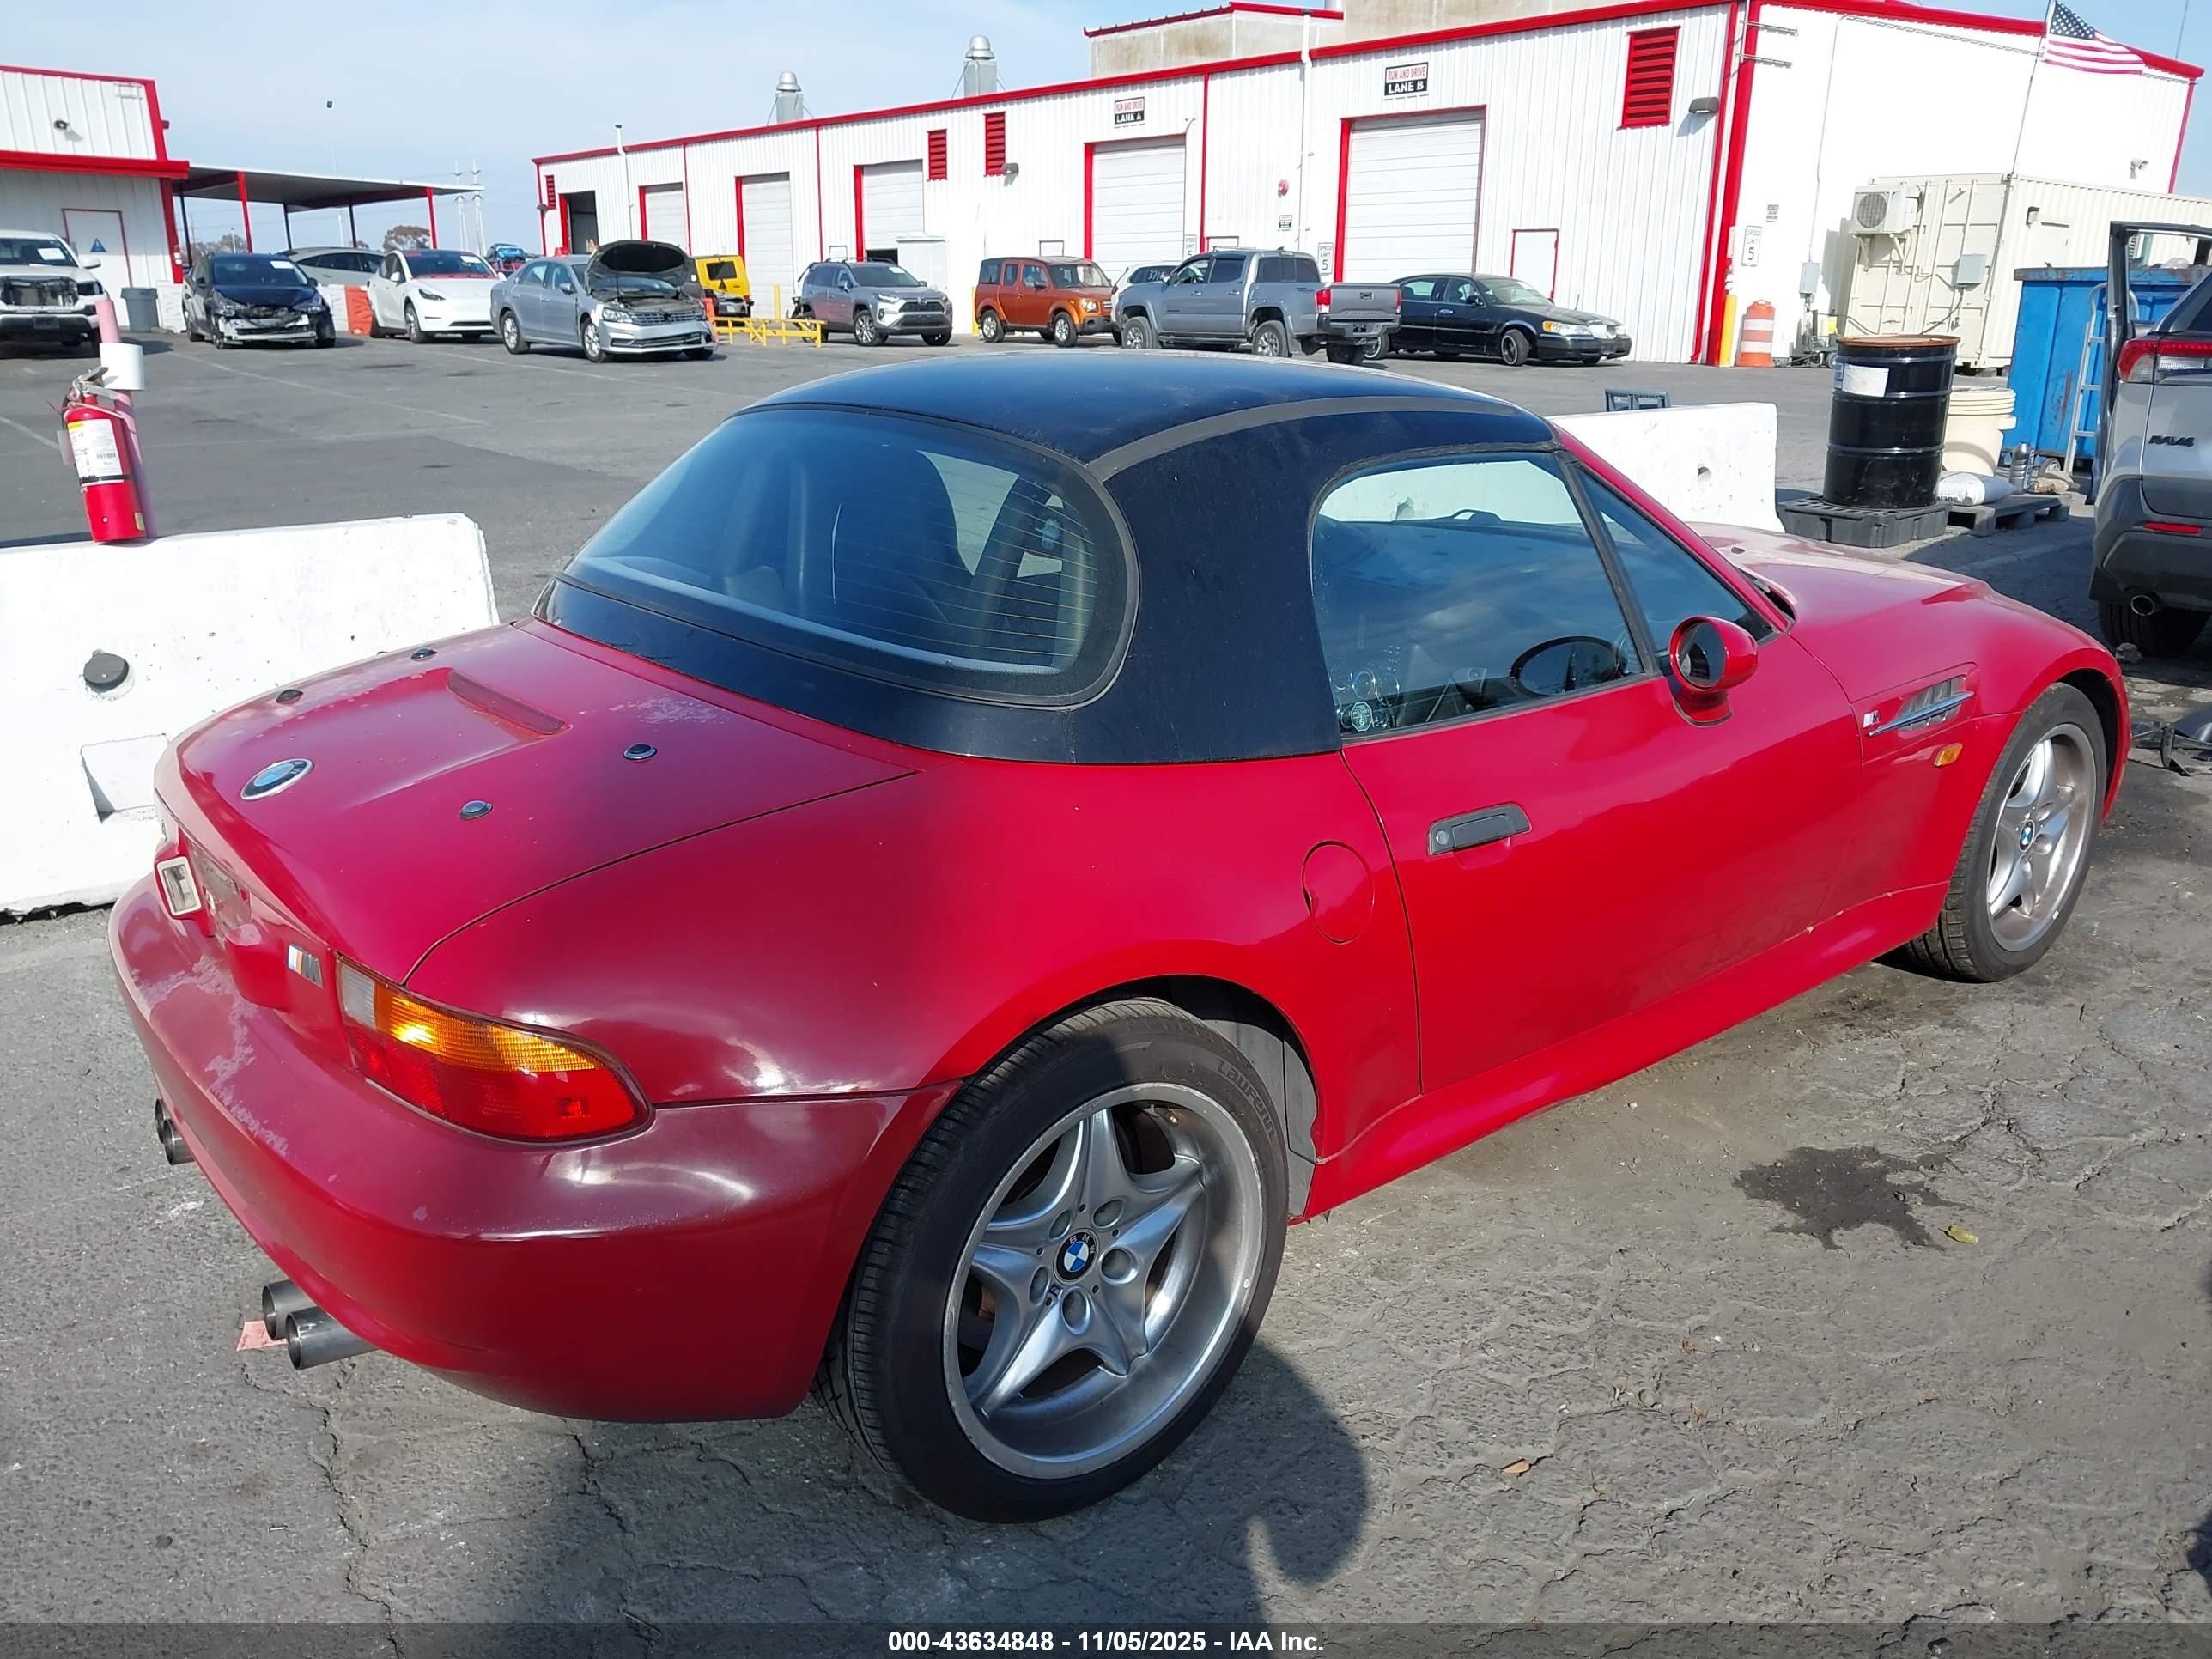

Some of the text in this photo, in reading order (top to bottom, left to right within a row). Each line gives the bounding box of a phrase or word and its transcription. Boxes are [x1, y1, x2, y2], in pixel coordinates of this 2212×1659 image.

[1388, 81, 1425, 94] LANE B
[1116, 112, 1142, 124] LANE A
[1747, 246, 1754, 260] 5
[1322, 259, 1328, 270] 5
[2148, 435, 2195, 447] RAV4
[1069, 1234, 1097, 1255] BMW
